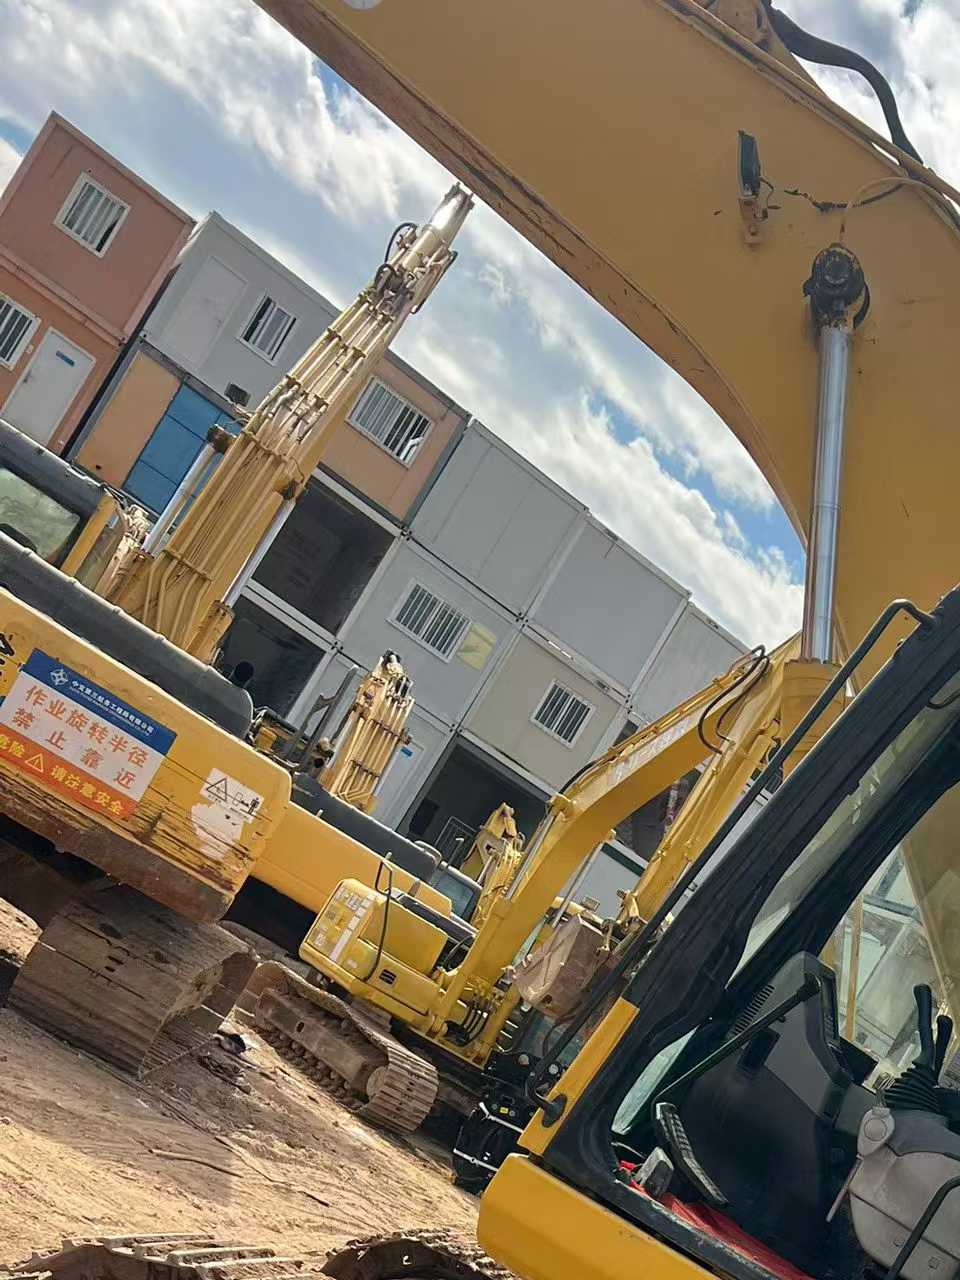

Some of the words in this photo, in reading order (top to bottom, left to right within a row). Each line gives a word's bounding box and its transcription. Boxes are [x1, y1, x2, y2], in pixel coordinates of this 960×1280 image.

[12, 707, 137, 789] 禁止靠近
[24, 685, 150, 768] 作业旋转半径
[51, 767, 125, 816] 请注意安全
